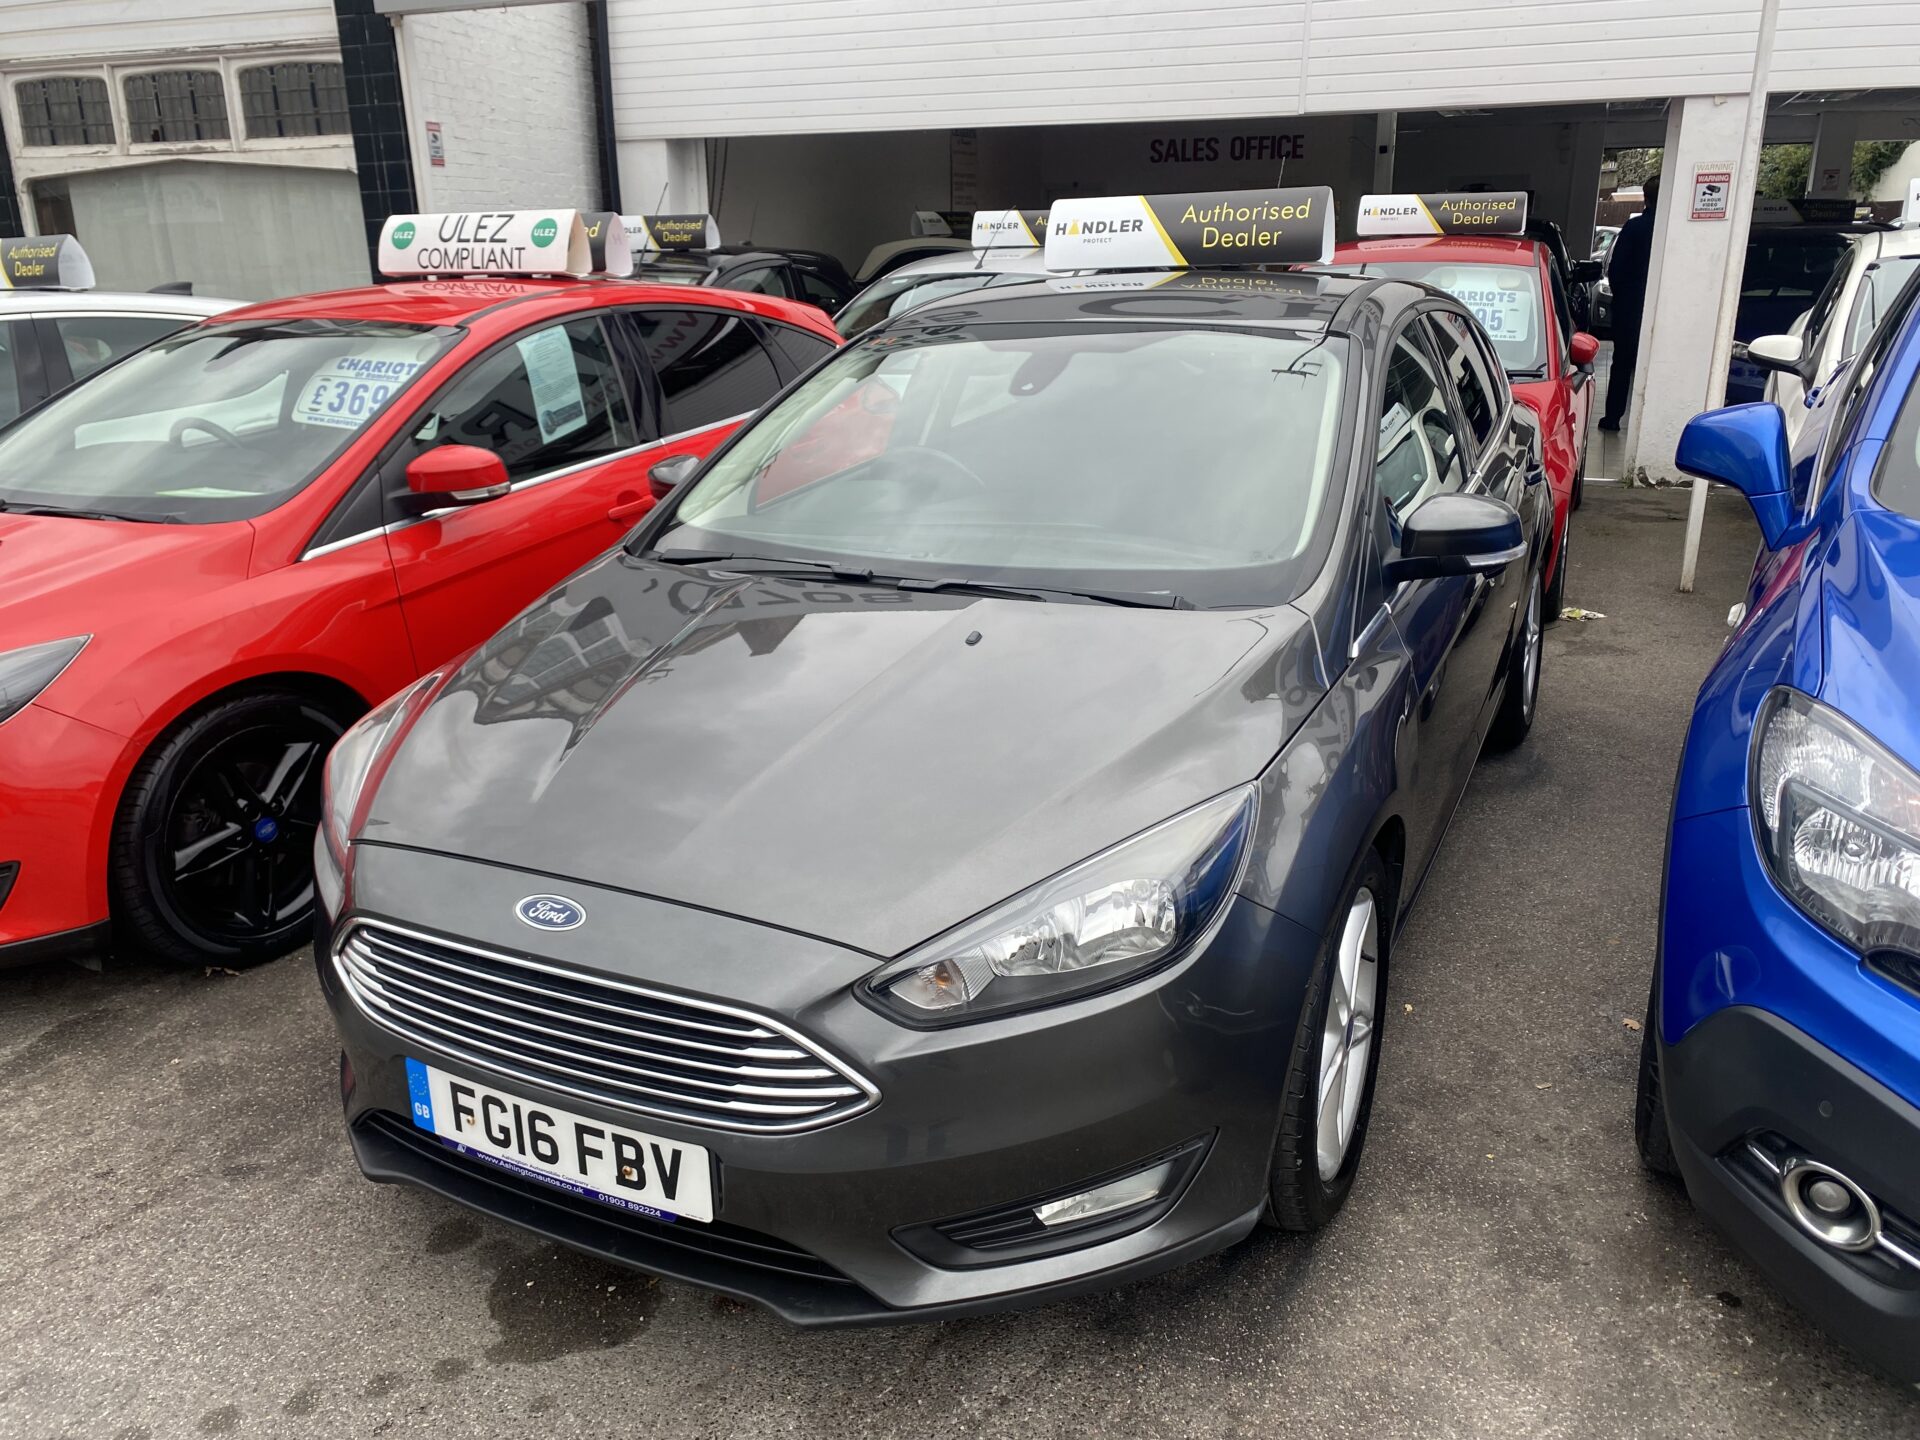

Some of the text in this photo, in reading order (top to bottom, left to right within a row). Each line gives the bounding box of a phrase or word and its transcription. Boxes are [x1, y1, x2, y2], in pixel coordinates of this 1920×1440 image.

[1150, 135, 1304, 163] SALES OFFICE
[1180, 198, 1312, 224] Authorised
[1440, 198, 1516, 211] Authorised
[438, 214, 516, 243] ULEZ
[655, 220, 702, 231] Authorised
[1453, 212, 1499, 225] Dealer
[393, 231, 414, 239] ULEZ
[533, 228, 555, 237] ULEZ
[663, 231, 692, 242] Dealer
[1202, 224, 1282, 248] Dealer
[8, 242, 58, 259] Authorised
[417, 247, 526, 270] COMPLIANT
[15, 260, 44, 276] Dealer
[337, 358, 418, 375] CHARIOT
[311, 381, 390, 415] £369
[529, 901, 571, 924] Ford
[414, 1102, 430, 1118] GB
[450, 1081, 682, 1201] FG16 FBV
[477, 1152, 584, 1194] www.Ashingtonautos.co.uk
[598, 1193, 662, 1217] 01903 892224
